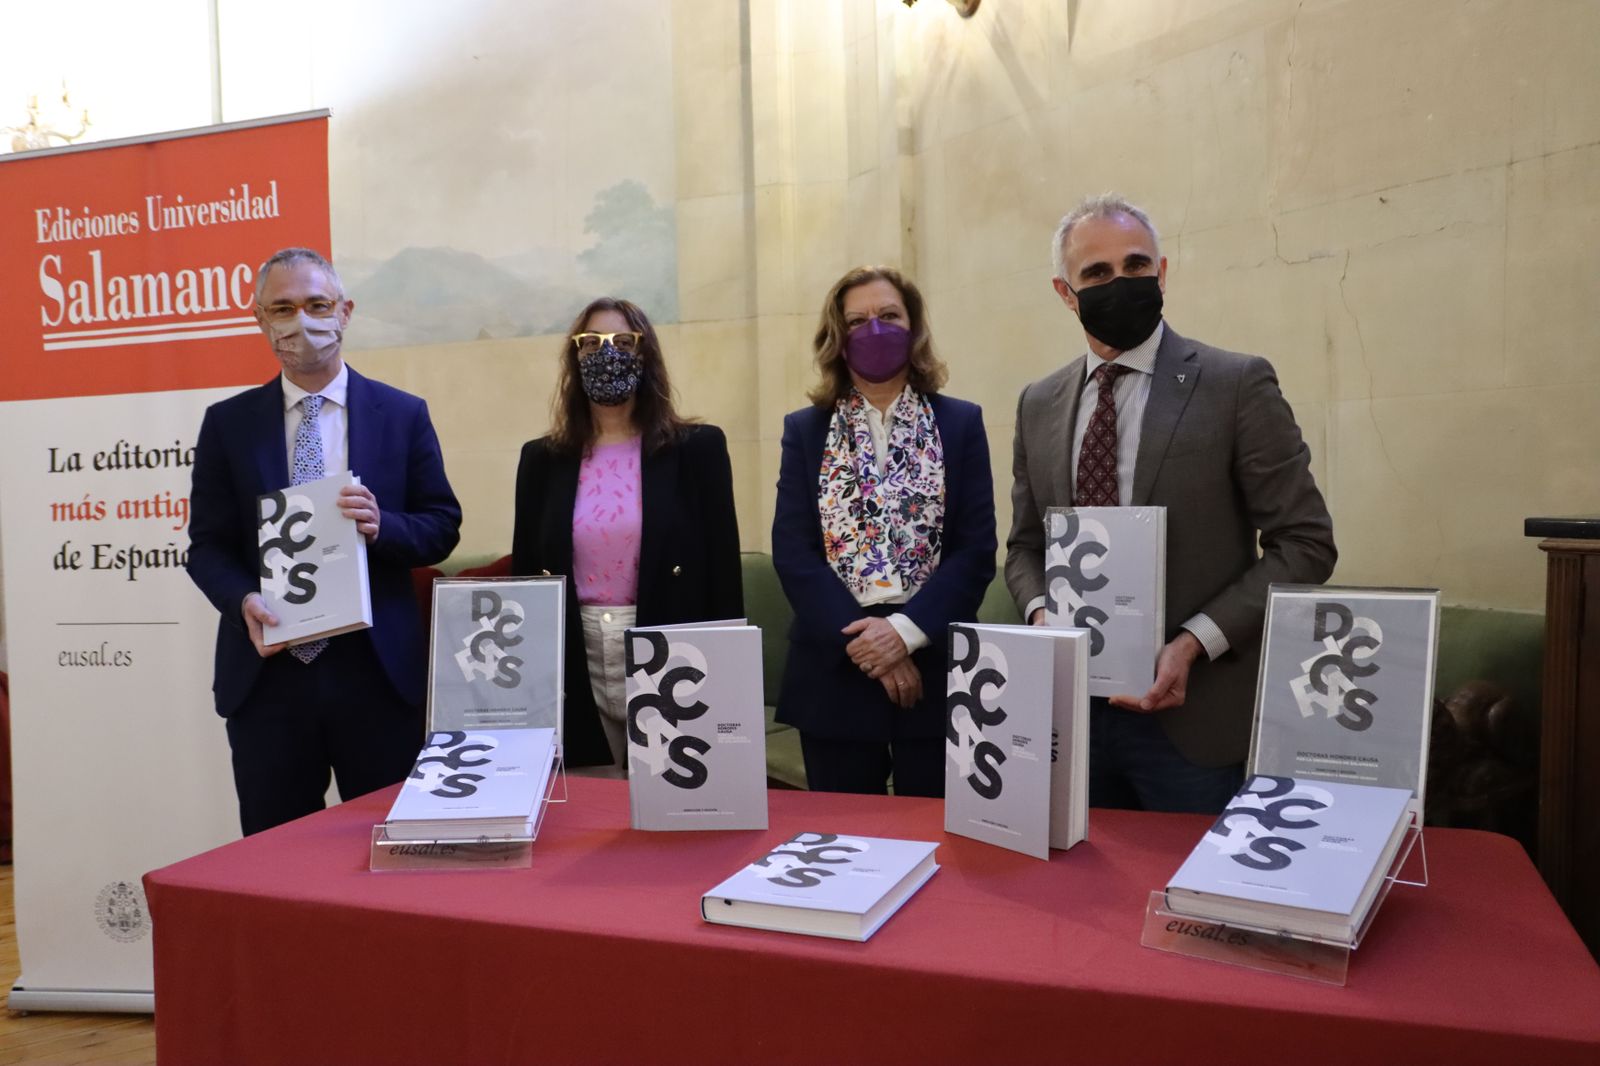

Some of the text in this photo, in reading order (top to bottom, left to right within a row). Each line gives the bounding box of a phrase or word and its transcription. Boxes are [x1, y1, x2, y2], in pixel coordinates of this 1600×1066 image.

[35, 180, 280, 243] Ediciones Universidad
[39, 250, 265, 327] Salamanc
[48, 447, 84, 473] La
[50, 493, 107, 522] más
[53, 541, 82, 571] de
[58, 641, 133, 667] eusal.es
[1165, 919, 1250, 946] eusal.es
